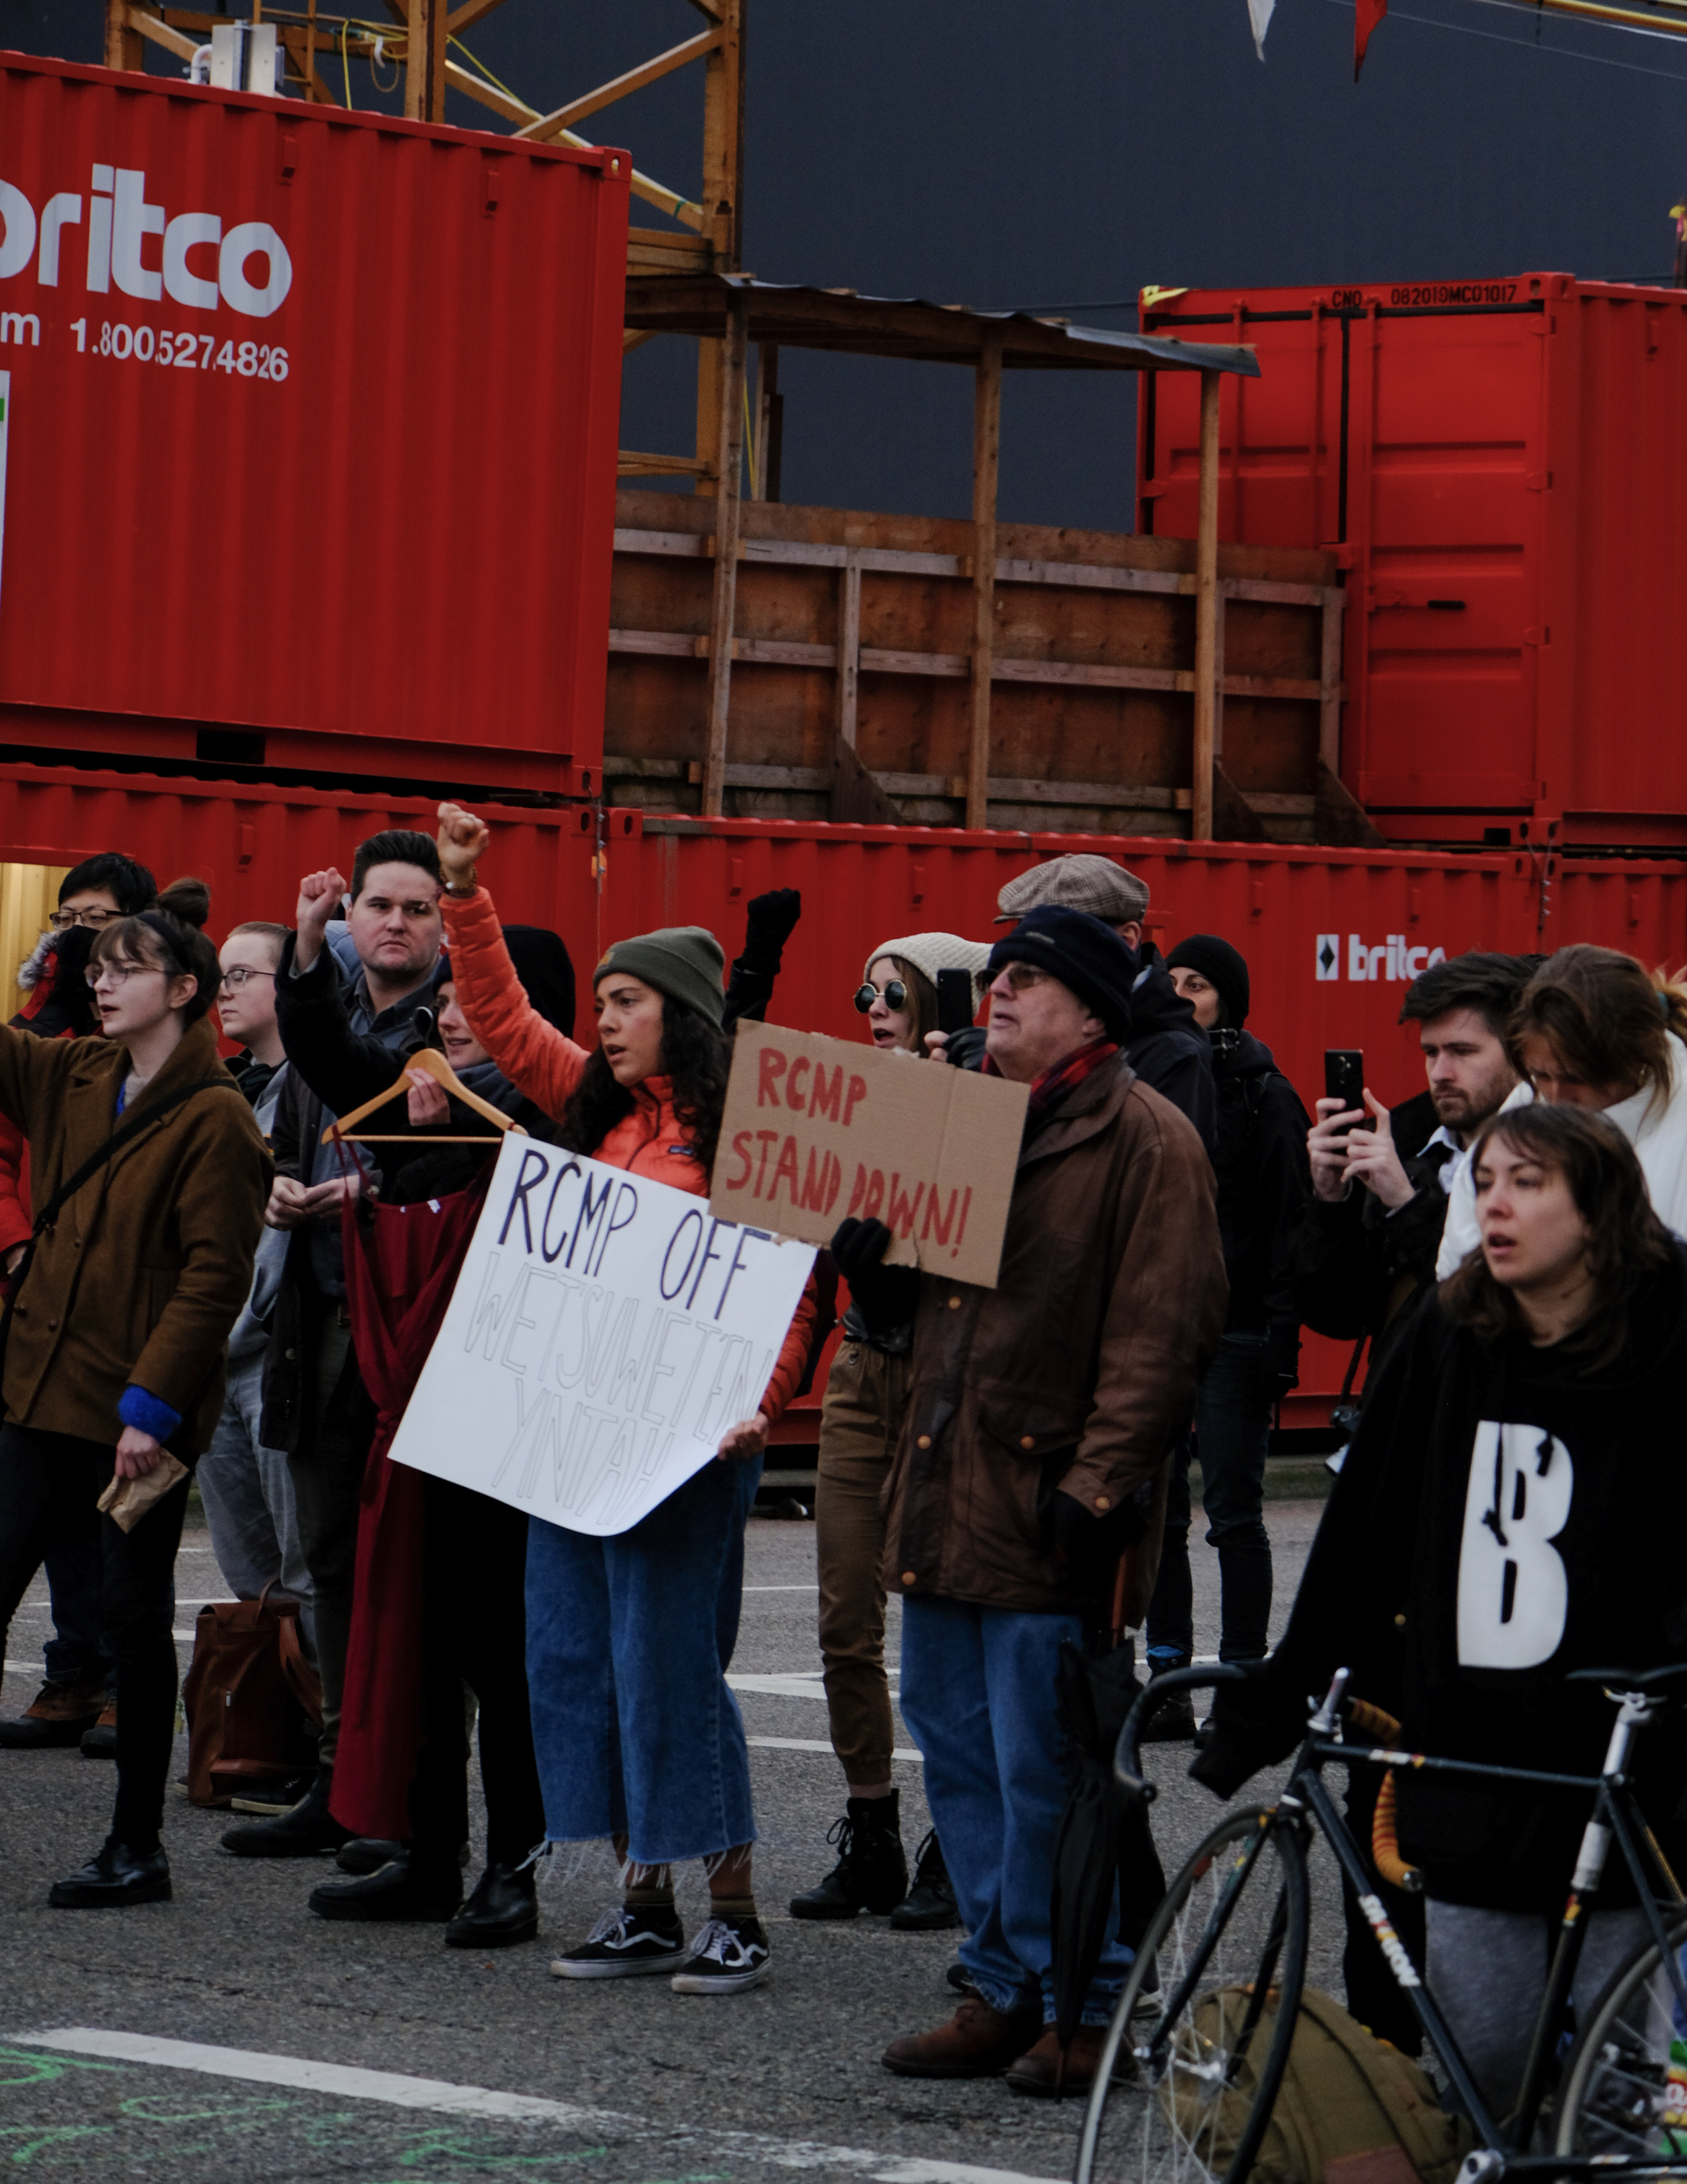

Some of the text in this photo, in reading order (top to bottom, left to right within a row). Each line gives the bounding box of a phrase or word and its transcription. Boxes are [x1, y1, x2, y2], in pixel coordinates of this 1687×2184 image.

[1332, 290, 1362, 307] CNO
[758, 1047, 867, 1126] RCMP
[498, 1149, 772, 1320] RCMP OFF
[726, 1130, 972, 1257] STAND DOWN!
[491, 1377, 676, 1527] YINTAH
[1456, 1419, 1575, 1670] B
